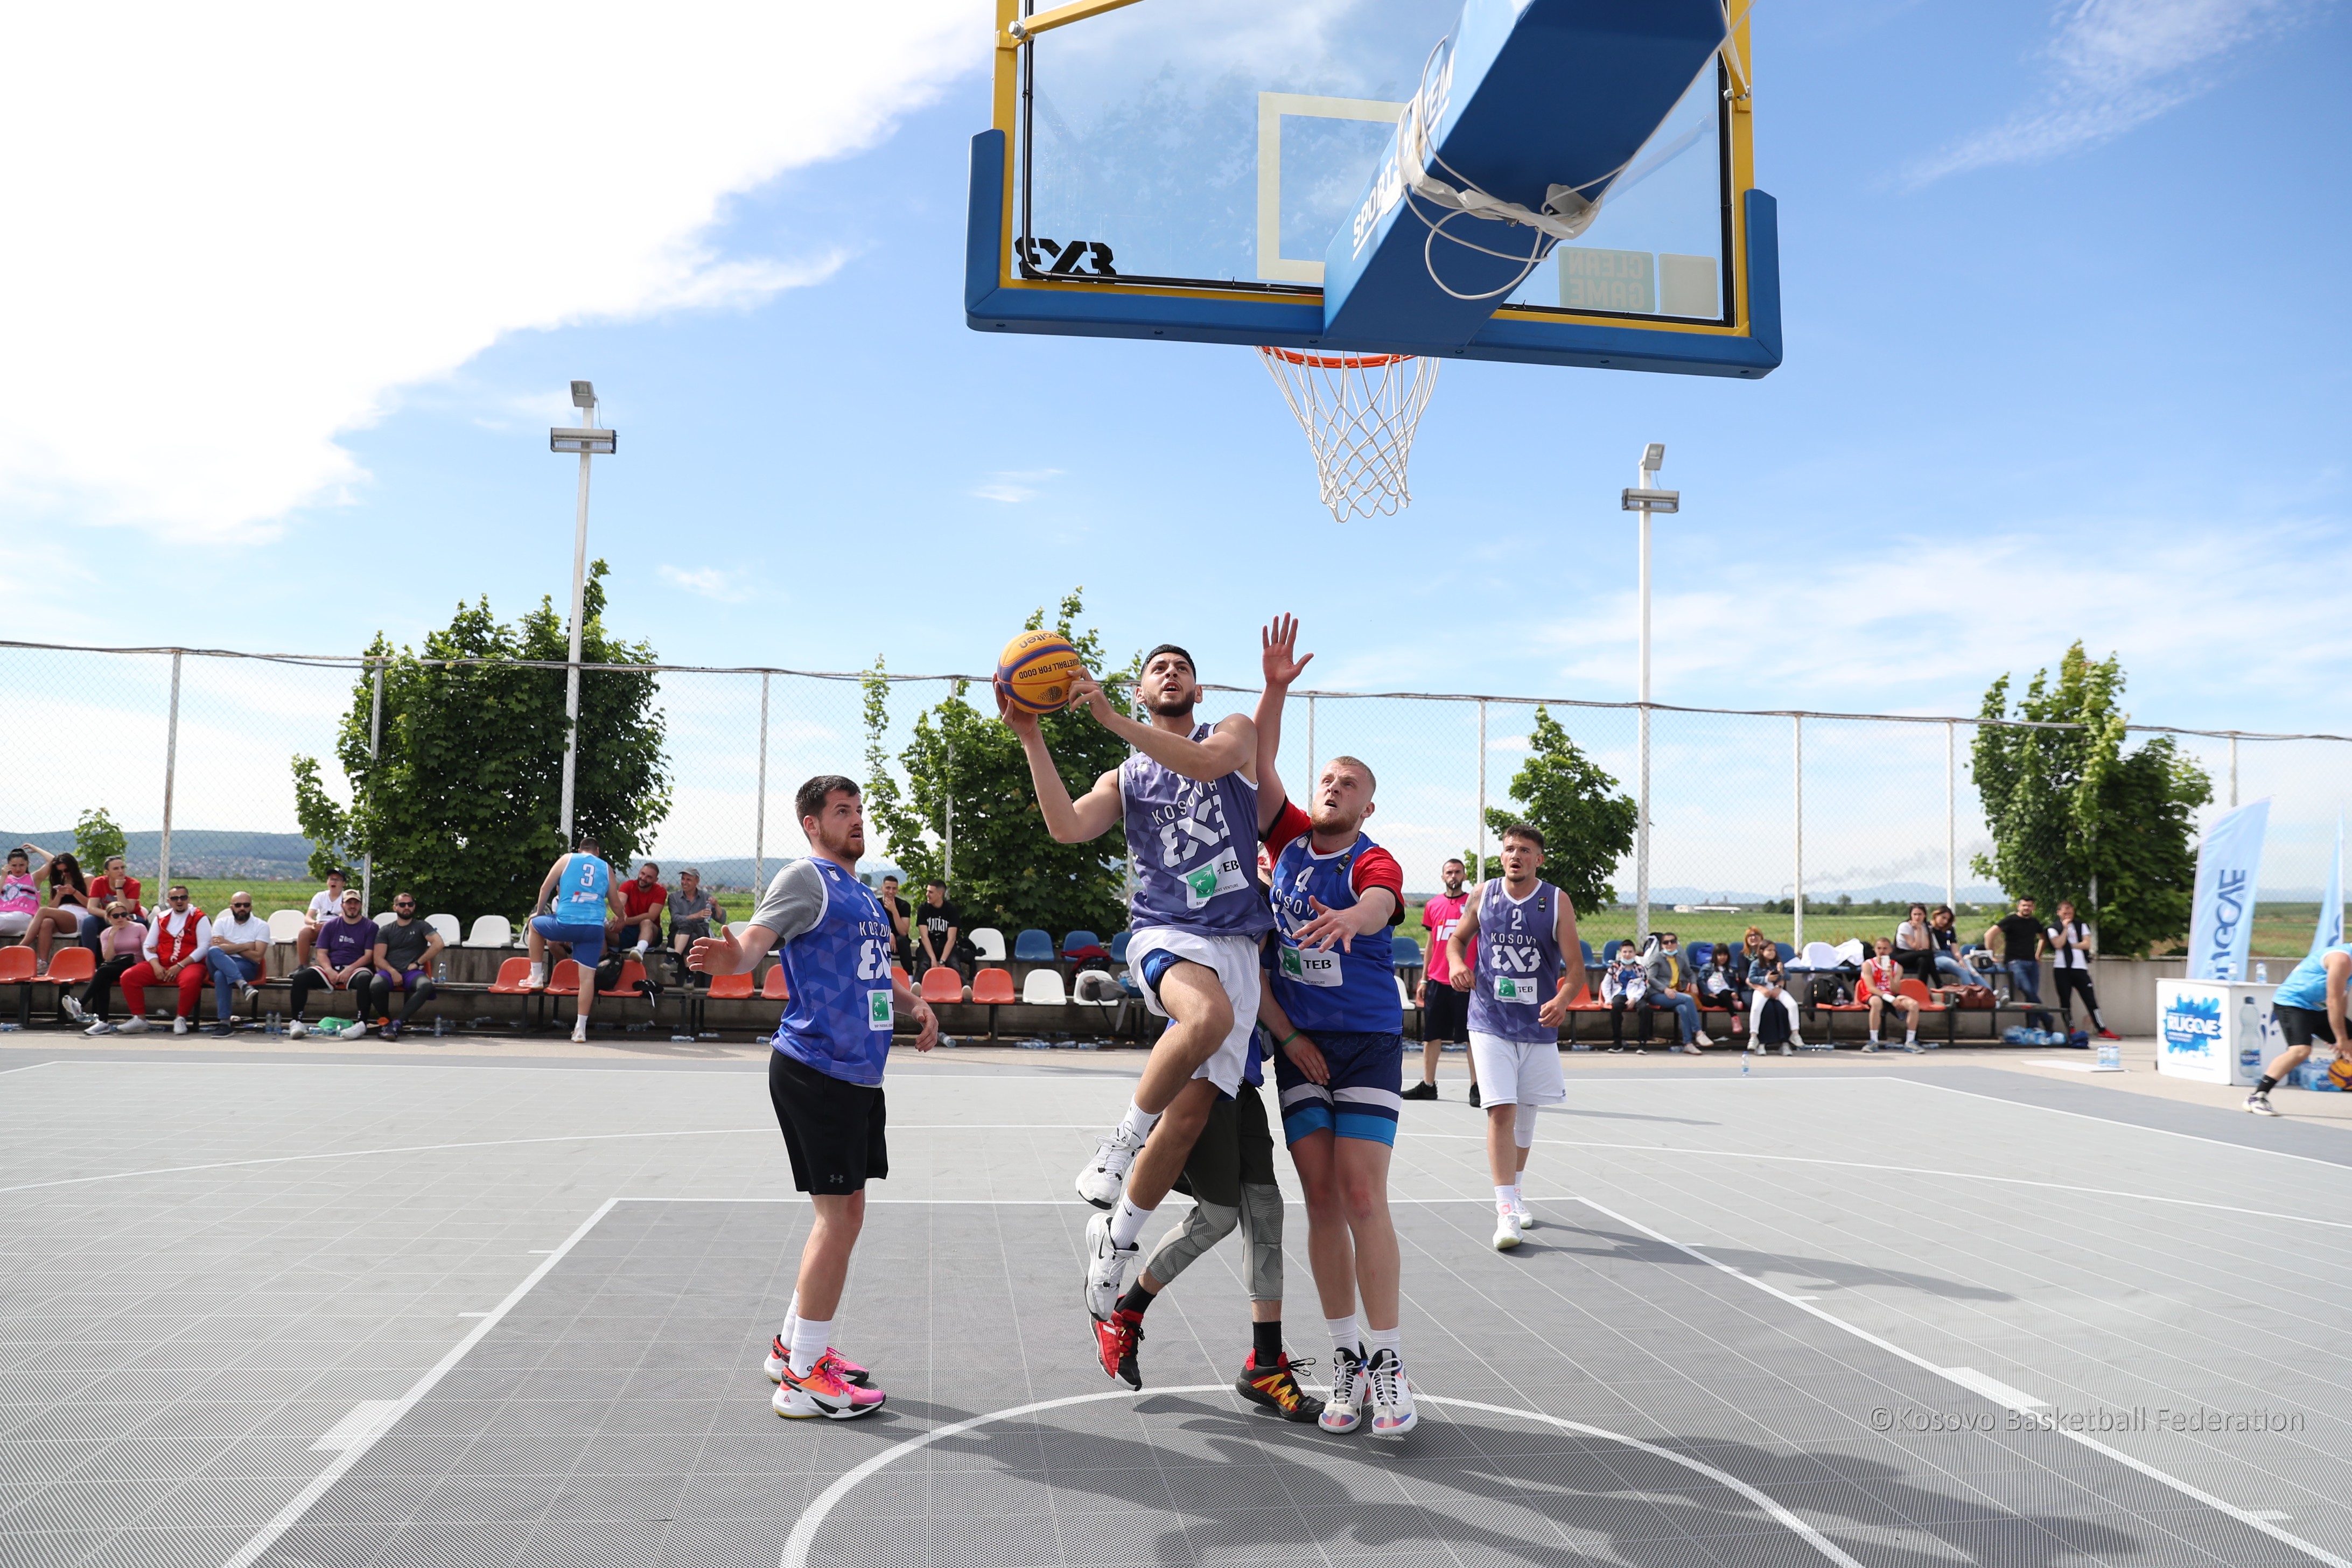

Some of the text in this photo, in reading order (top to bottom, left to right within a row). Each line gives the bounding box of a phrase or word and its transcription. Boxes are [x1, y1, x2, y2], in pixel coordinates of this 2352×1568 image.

[1019, 669, 1037, 679] GOOD
[1038, 665, 1052, 674] FOR
[580, 863, 596, 888] 3
[1295, 866, 1315, 893] 4
[862, 891, 880, 918] 1
[859, 921, 891, 937] KOSOV
[1511, 908, 1522, 930] 2
[2210, 869, 2246, 979] UGOVE
[1303, 959, 1332, 970] TEB
